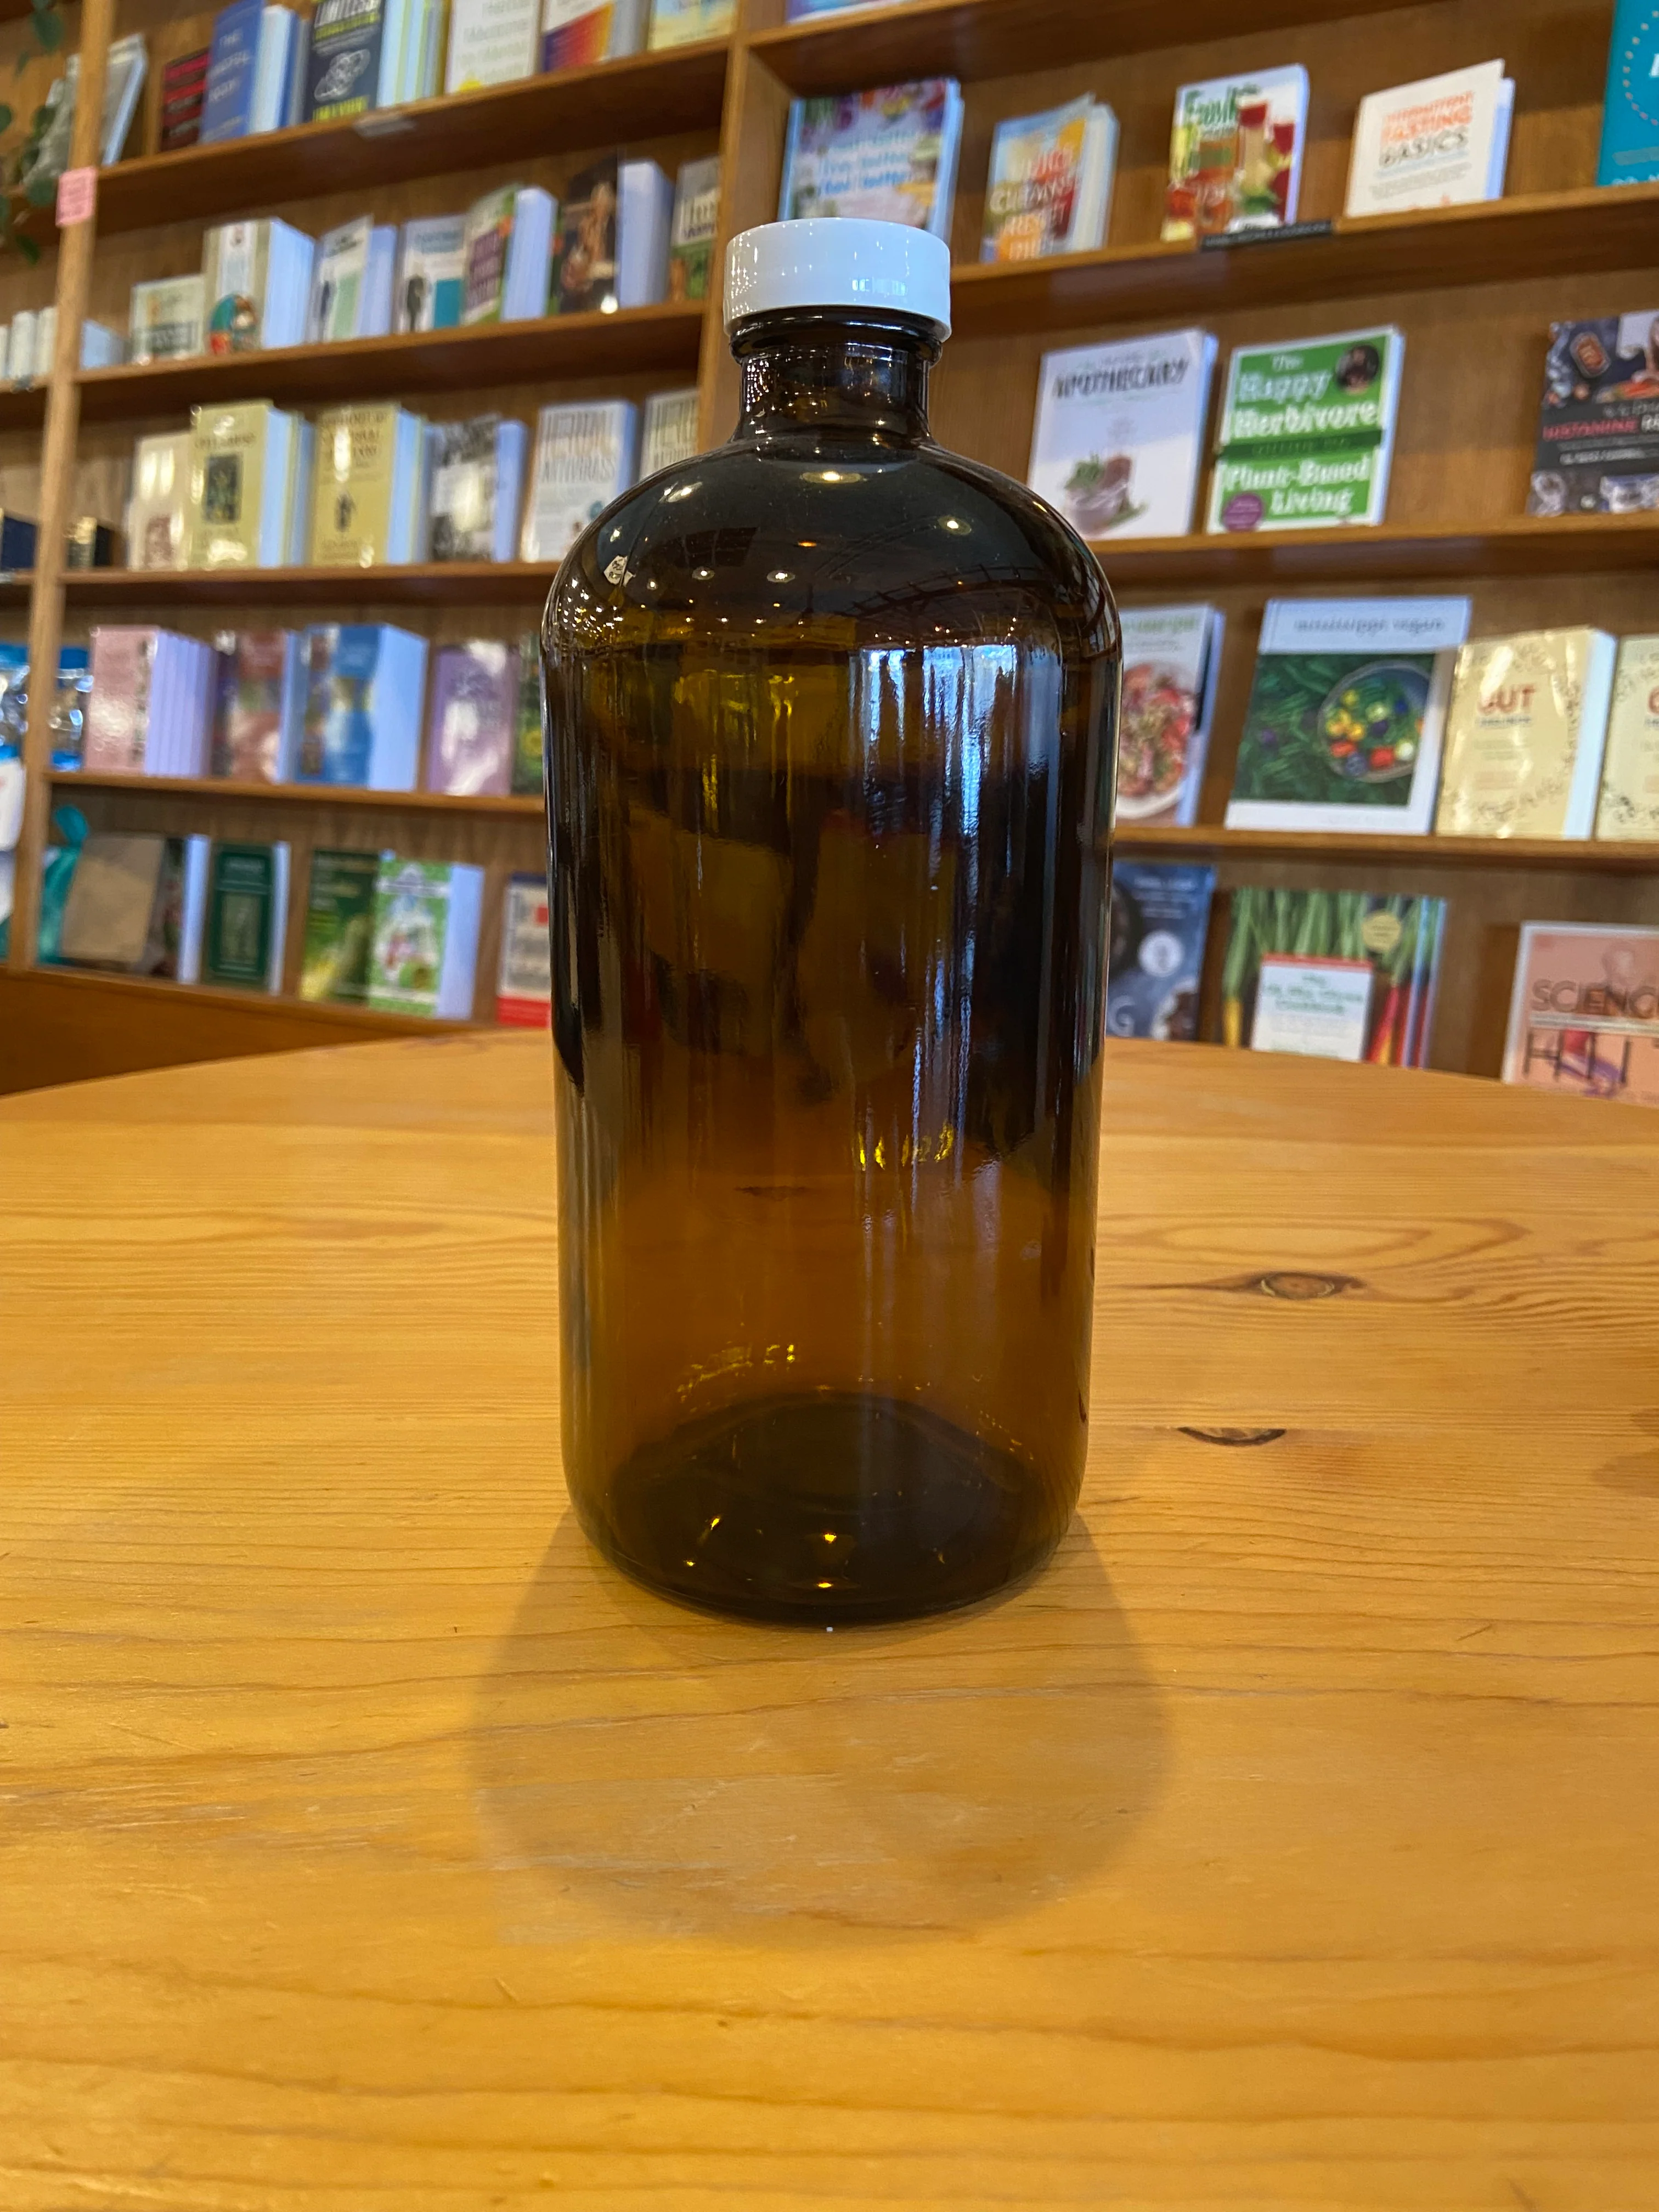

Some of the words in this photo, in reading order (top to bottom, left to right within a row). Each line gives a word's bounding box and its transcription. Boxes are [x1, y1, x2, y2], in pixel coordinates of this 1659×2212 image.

[1379, 125, 1469, 168] BASICS
[1232, 403, 1378, 439] Herbivore
[1268, 487, 1352, 516] Living
[1531, 978, 1659, 1019] SCIENC
